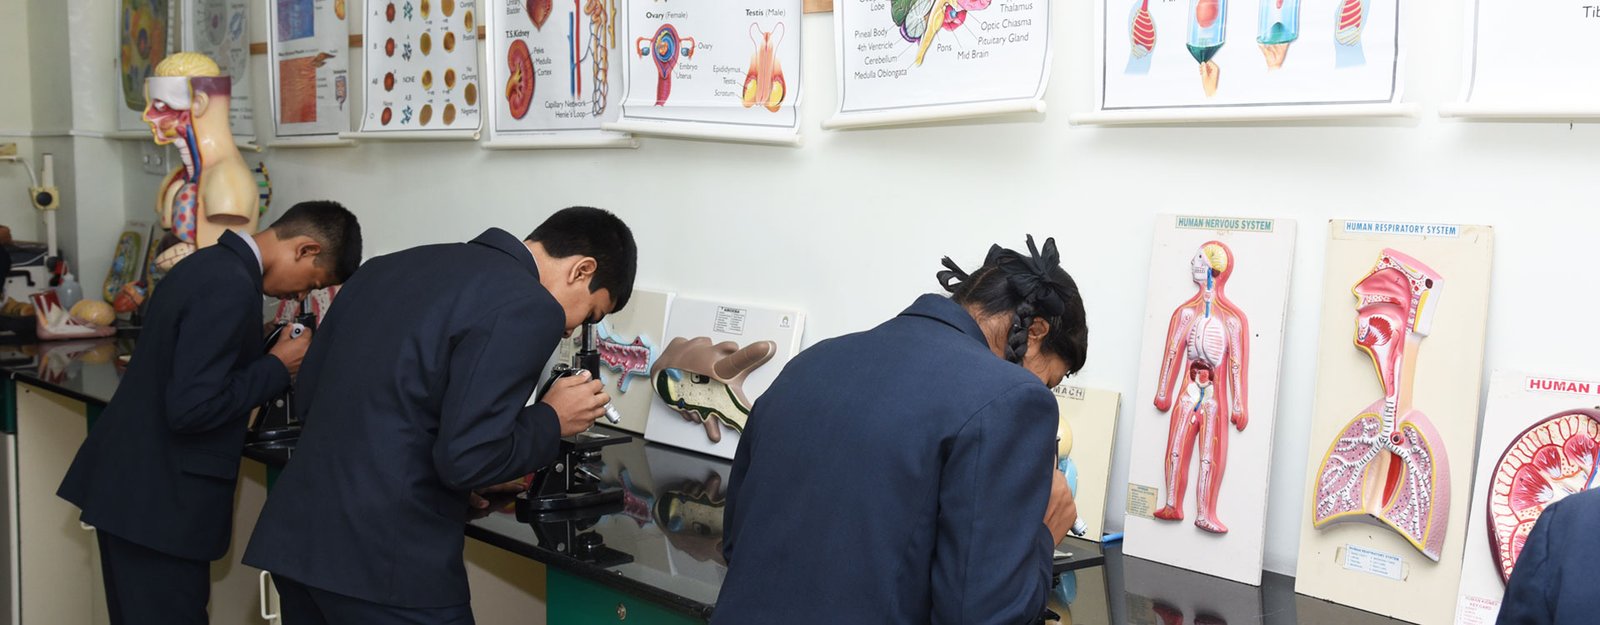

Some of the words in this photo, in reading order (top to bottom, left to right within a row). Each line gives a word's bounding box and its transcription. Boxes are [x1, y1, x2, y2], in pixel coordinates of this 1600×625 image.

[1000, 3, 1033, 12] Thalamus
[646, 12, 664, 20] Ovary
[765, 8, 786, 17] (Male)
[980, 21, 1000, 32] Optic
[1002, 18, 1032, 28] Chiasma
[854, 29, 872, 38] Pineal
[874, 28, 888, 38] Body
[978, 36, 1006, 46] Pituitary
[1008, 32, 1030, 42] Gland
[698, 42, 713, 50] Ovary
[858, 44, 867, 52] 4th
[868, 41, 894, 50] Ventricle
[936, 43, 952, 52] Pons
[958, 50, 970, 60] Mid
[972, 50, 989, 58] Brain
[864, 56, 898, 65] Cerebellum
[679, 62, 698, 71] Embryo
[538, 68, 552, 76] Cortex
[854, 70, 876, 79] Medulla
[877, 69, 908, 78] Oblongata
[722, 76, 736, 84] Testis
[544, 100, 564, 109] Capillary
[574, 110, 586, 118] Loop
[1178, 218, 1204, 227] HUMAN
[1205, 218, 1240, 229] NERVOUS
[1241, 220, 1272, 230] SYSTEM
[1346, 222, 1372, 232] HUMAN
[1374, 224, 1424, 234] RESPIRATORY
[1426, 227, 1456, 235] SYSTEM
[1530, 379, 1590, 393] HUMAN
